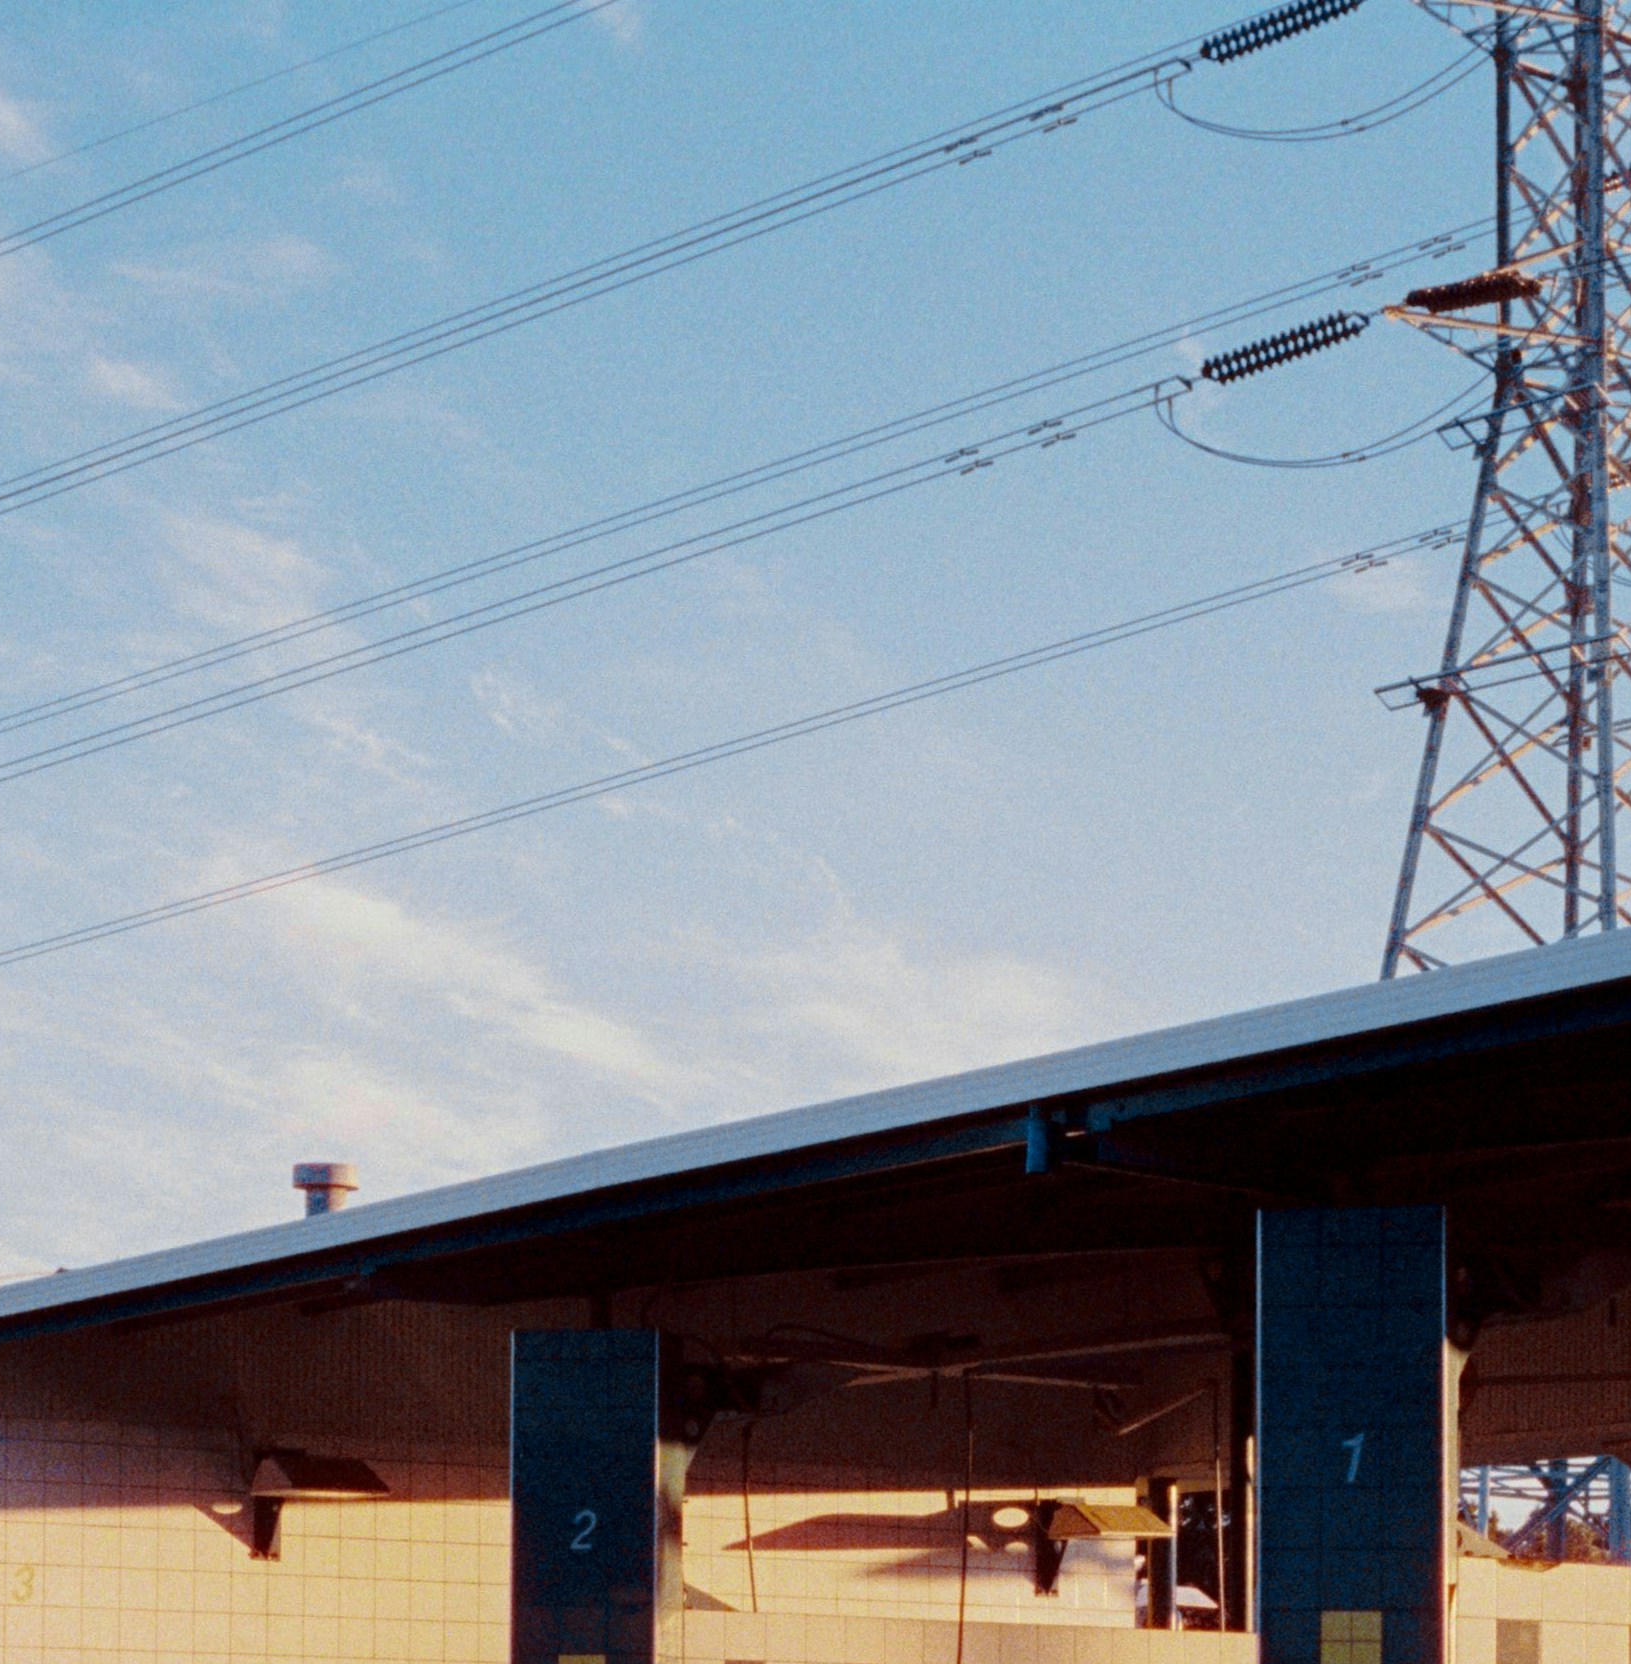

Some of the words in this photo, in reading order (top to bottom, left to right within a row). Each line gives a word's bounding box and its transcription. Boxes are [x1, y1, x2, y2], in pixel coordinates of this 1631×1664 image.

[1341, 1432, 1365, 1482] 1
[570, 1509, 597, 1550] 2
[13, 1564, 35, 1602] 3
